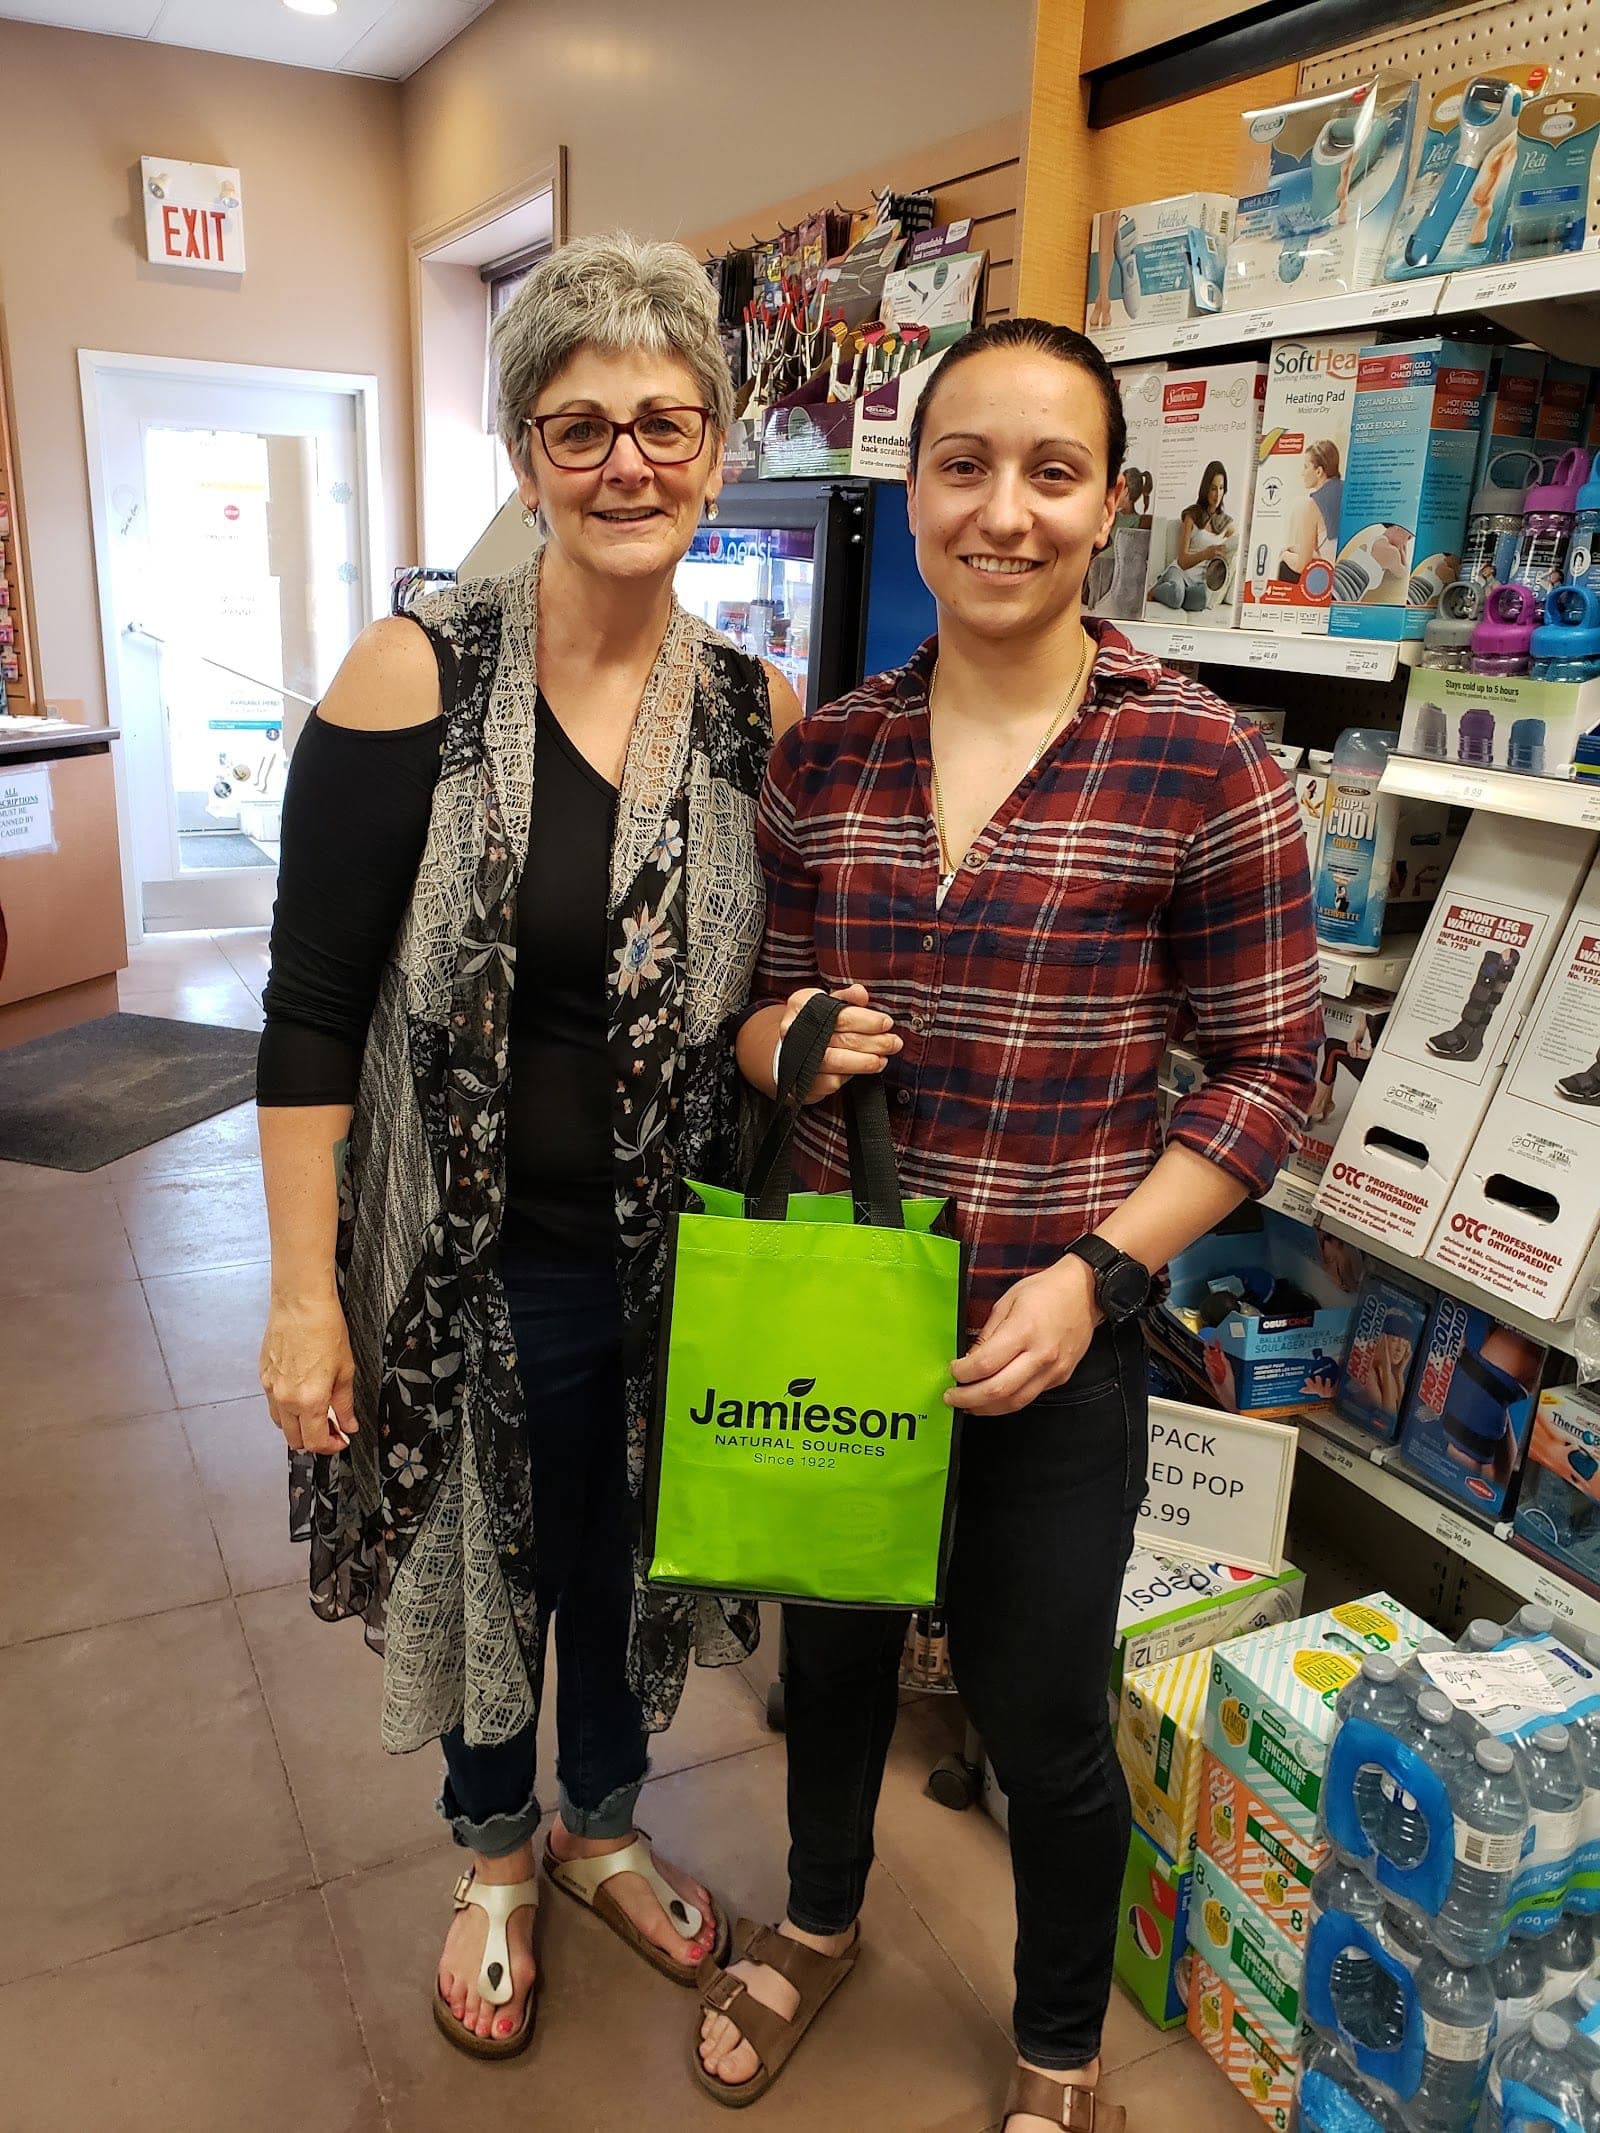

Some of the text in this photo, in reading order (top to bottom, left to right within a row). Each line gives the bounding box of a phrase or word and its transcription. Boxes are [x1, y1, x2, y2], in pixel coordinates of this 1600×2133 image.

[162, 204, 226, 262] EXIT
[1390, 369, 1432, 379] CHAUD FROID
[1399, 360, 1432, 371] HOT COLD
[1167, 386, 1199, 406] Sunbeam
[1285, 389, 1346, 406] Heating Pad
[1447, 399, 1480, 409] HOT COLD
[1298, 406, 1313, 414] Moist
[1320, 405, 1331, 414] Dry
[1437, 408, 1480, 417] CHAUD FROID
[1143, 417, 1159, 428] Pad
[1200, 422, 1229, 433] Heating
[1231, 420, 1247, 430] Pad
[861, 443, 879, 453] back
[1445, 679, 1520, 696] Stays cold up to 5 hours
[5, 787, 18, 798] ALL
[0, 818, 24, 829] ANNED
[1458, 908, 1521, 933] SHORT LEG
[1439, 930, 1482, 948] INFLATABLE
[1446, 916, 1527, 946] WALKER BOOT
[1436, 938, 1469, 951] No. 1793
[1566, 971, 1580, 981] No.
[1521, 1139, 1546, 1154] OTC
[1332, 1162, 1366, 1190] OTC
[1364, 1186, 1423, 1215] ORTHOPAEDIC
[1368, 1175, 1429, 1208] PROFESSIONAL
[1450, 1213, 1488, 1243] OTC
[1487, 1238, 1555, 1274] ORTHOPAEDIC
[1490, 1228, 1564, 1267] PROFESSIONAL
[1488, 1265, 1512, 1283] Surgical
[1492, 1278, 1514, 1294] Canada
[1430, 1297, 1456, 1356] COLD
[714, 1433, 886, 1458] NATURAL SOURCES
[1150, 1424, 1217, 1457] PACK
[753, 1452, 836, 1470] Since 1922
[1192, 1471, 1244, 1498] POP
[1138, 1498, 1190, 1526] 6.99
[1123, 1567, 1211, 1612] pepsi
[1381, 1600, 1400, 1612] 8
[1135, 1648, 1151, 1668] 12
[1213, 1663, 1222, 1685] 8
[1129, 1690, 1142, 1709] 8
[1261, 1735, 1308, 1785] CONCOMBRE
[1270, 1757, 1302, 1795] MENTHE
[1259, 1829, 1298, 1874] WHITE PEACH
[1196, 1864, 1204, 1885] 8
[1291, 1909, 1303, 1932] 8
[1275, 2107, 1286, 2129] 8
